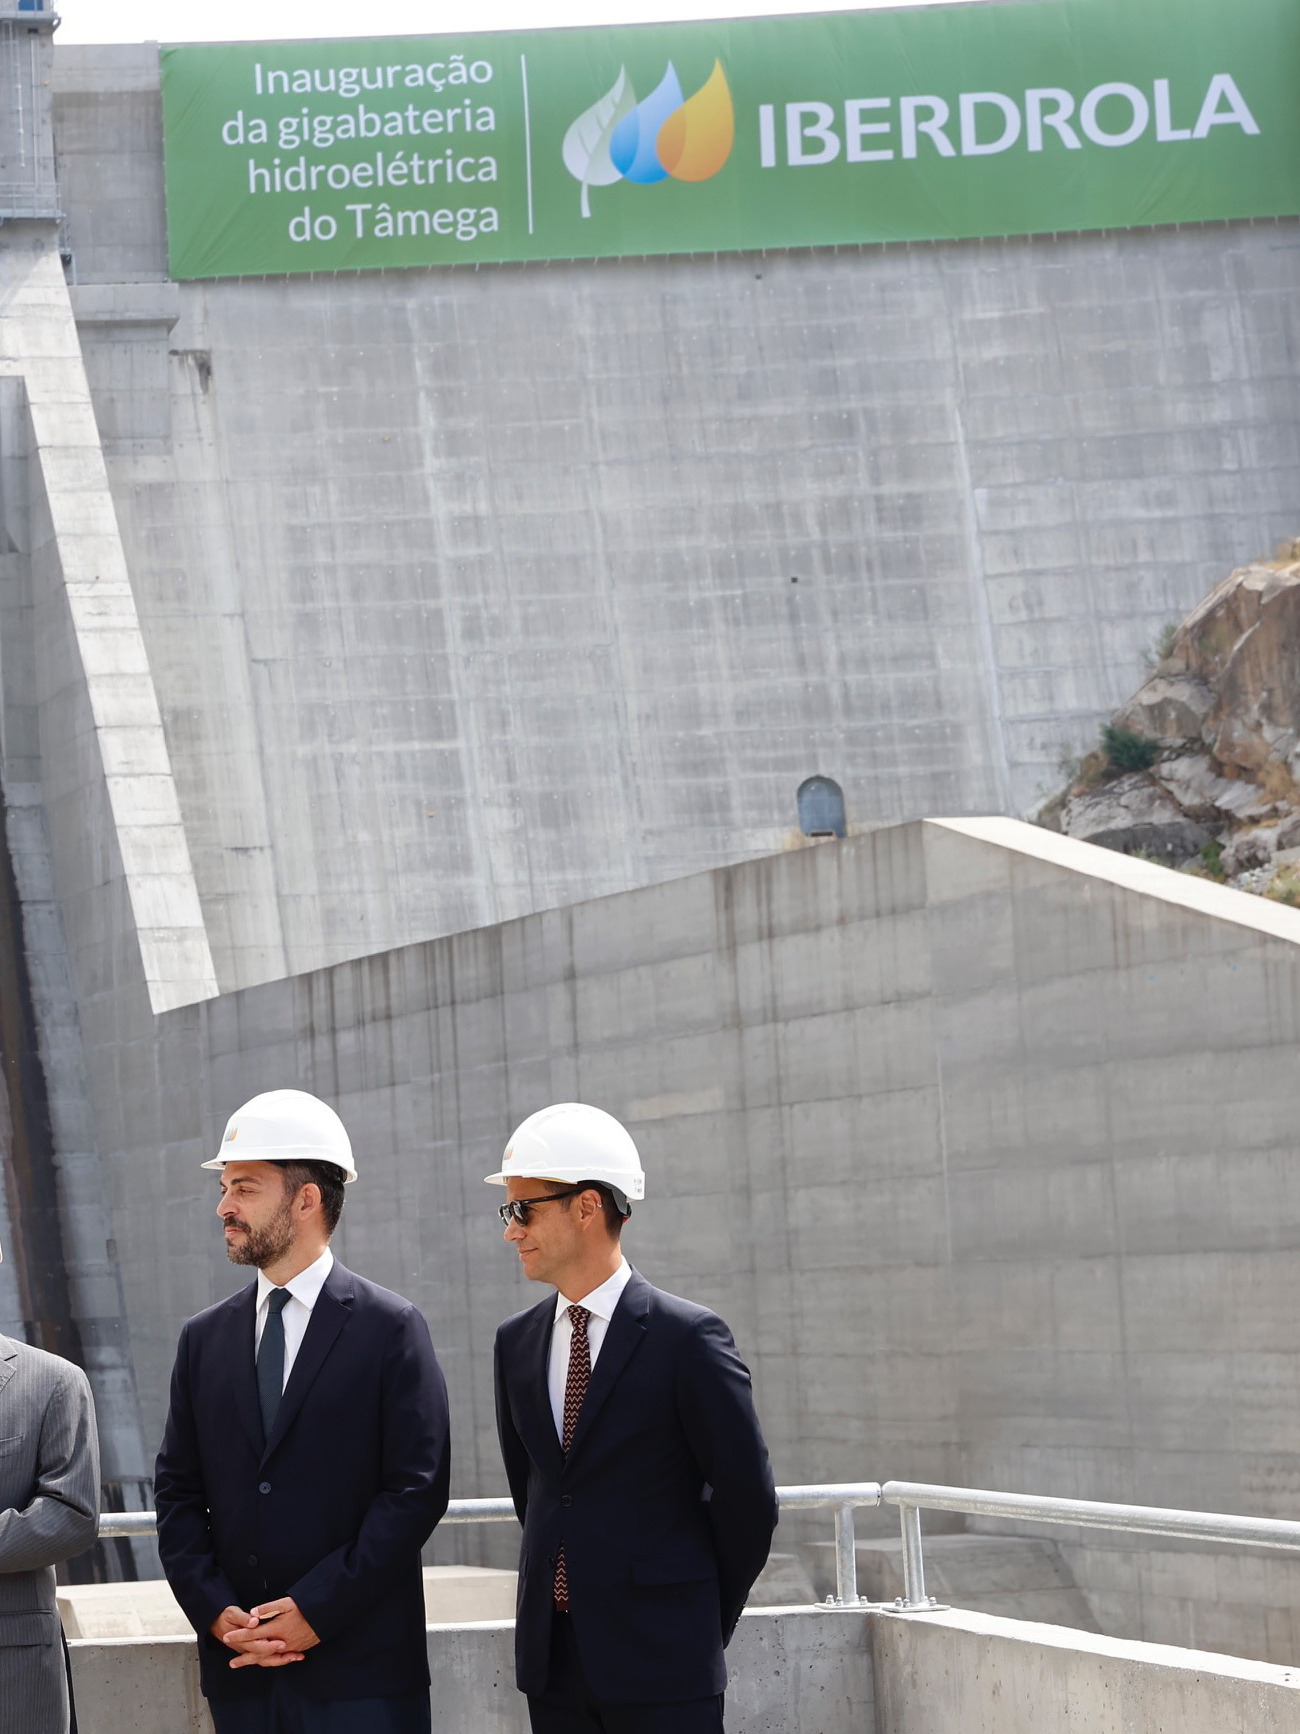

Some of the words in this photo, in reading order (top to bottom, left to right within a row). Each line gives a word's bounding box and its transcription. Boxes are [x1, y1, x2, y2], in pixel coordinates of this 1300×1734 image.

[254, 53, 493, 98] Inauguração
[222, 110, 268, 145] da
[278, 98, 495, 150] gigabateria
[759, 74, 1260, 167] IBERDROLA
[248, 148, 497, 194] hidroelétrica
[288, 206, 337, 242] do
[345, 203, 498, 241] Tâmega
